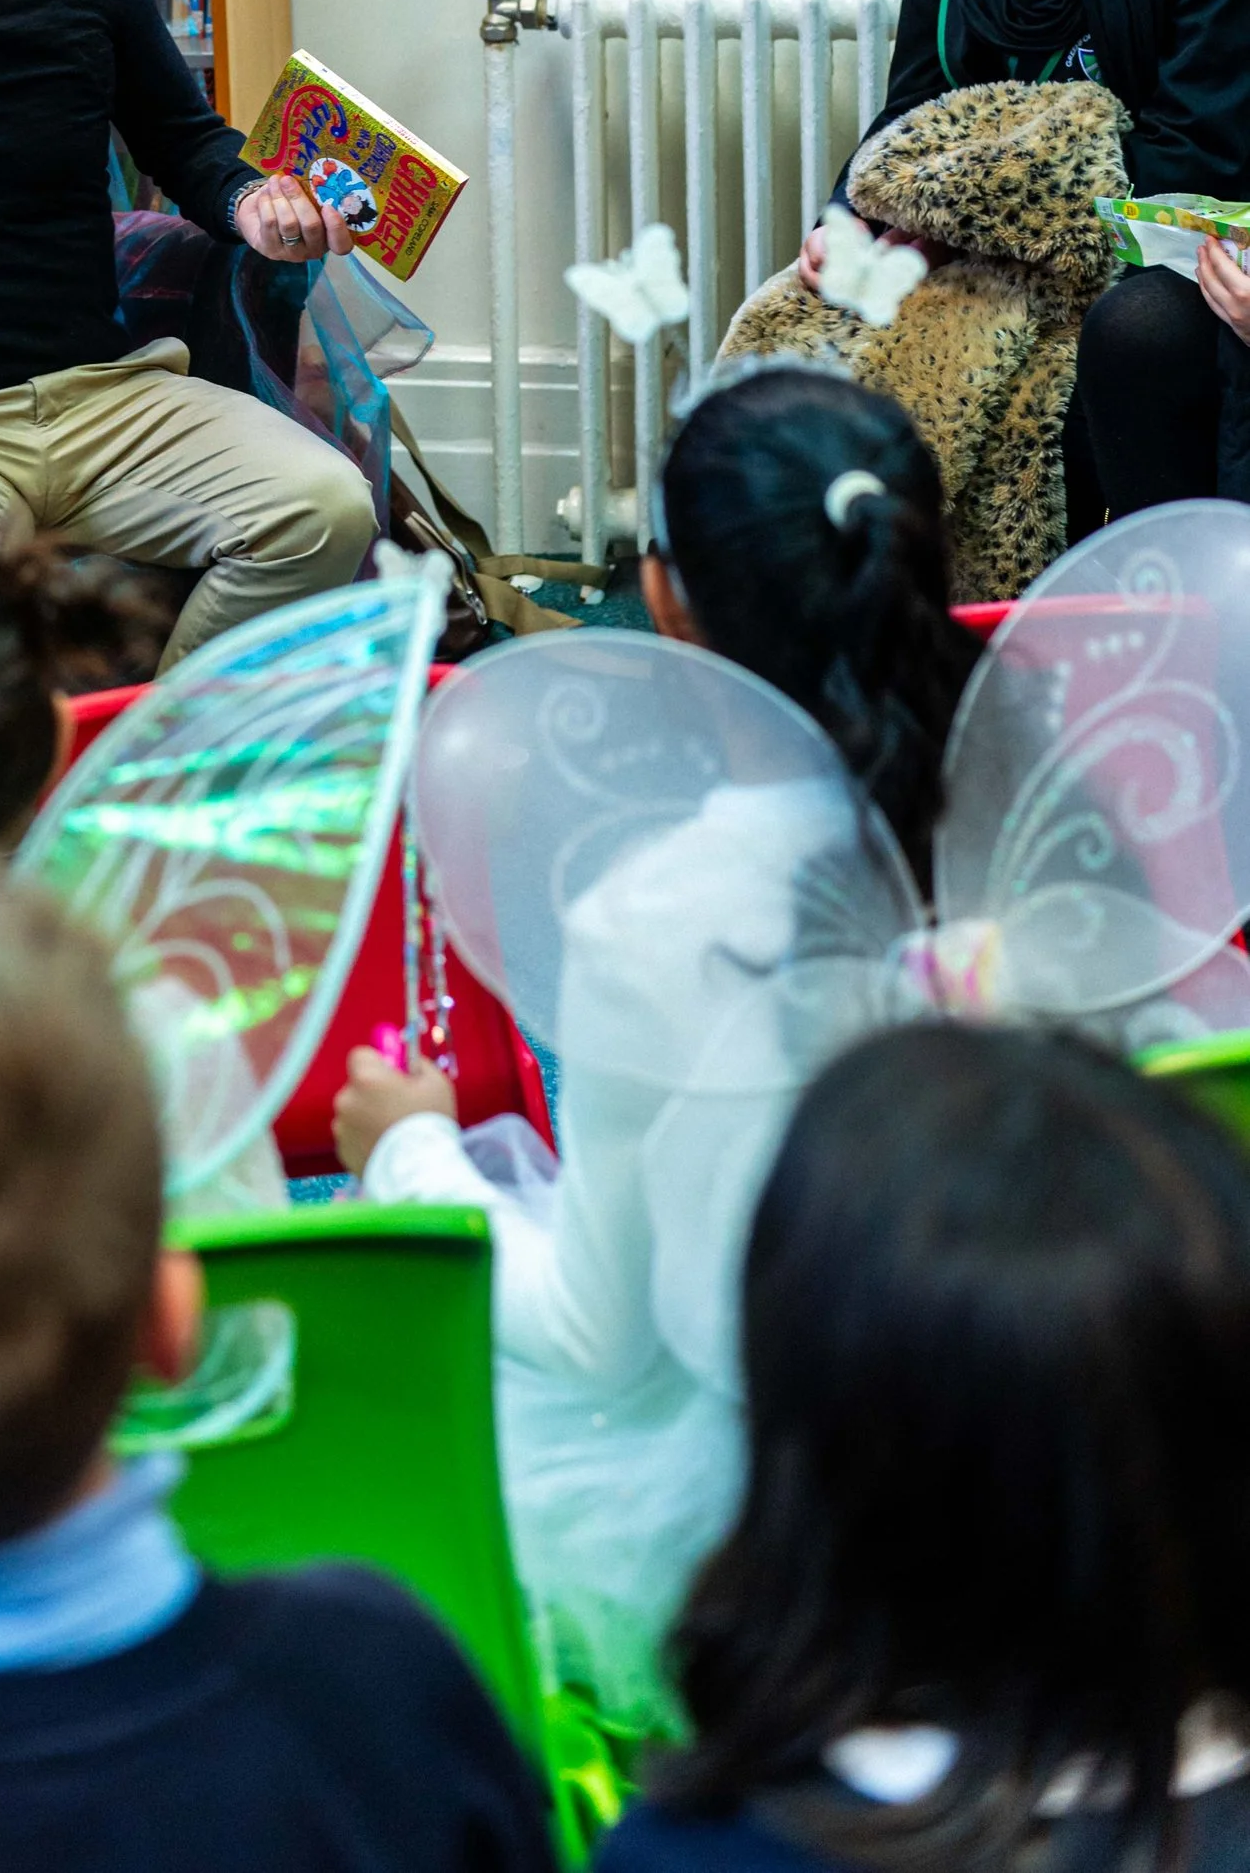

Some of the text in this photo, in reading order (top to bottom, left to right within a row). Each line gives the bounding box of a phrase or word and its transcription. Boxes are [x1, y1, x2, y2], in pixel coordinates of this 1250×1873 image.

[357, 132, 397, 184] CHANGES
[355, 154, 437, 267] CHARLIE
[405, 200, 440, 257] SAM COPELAND
